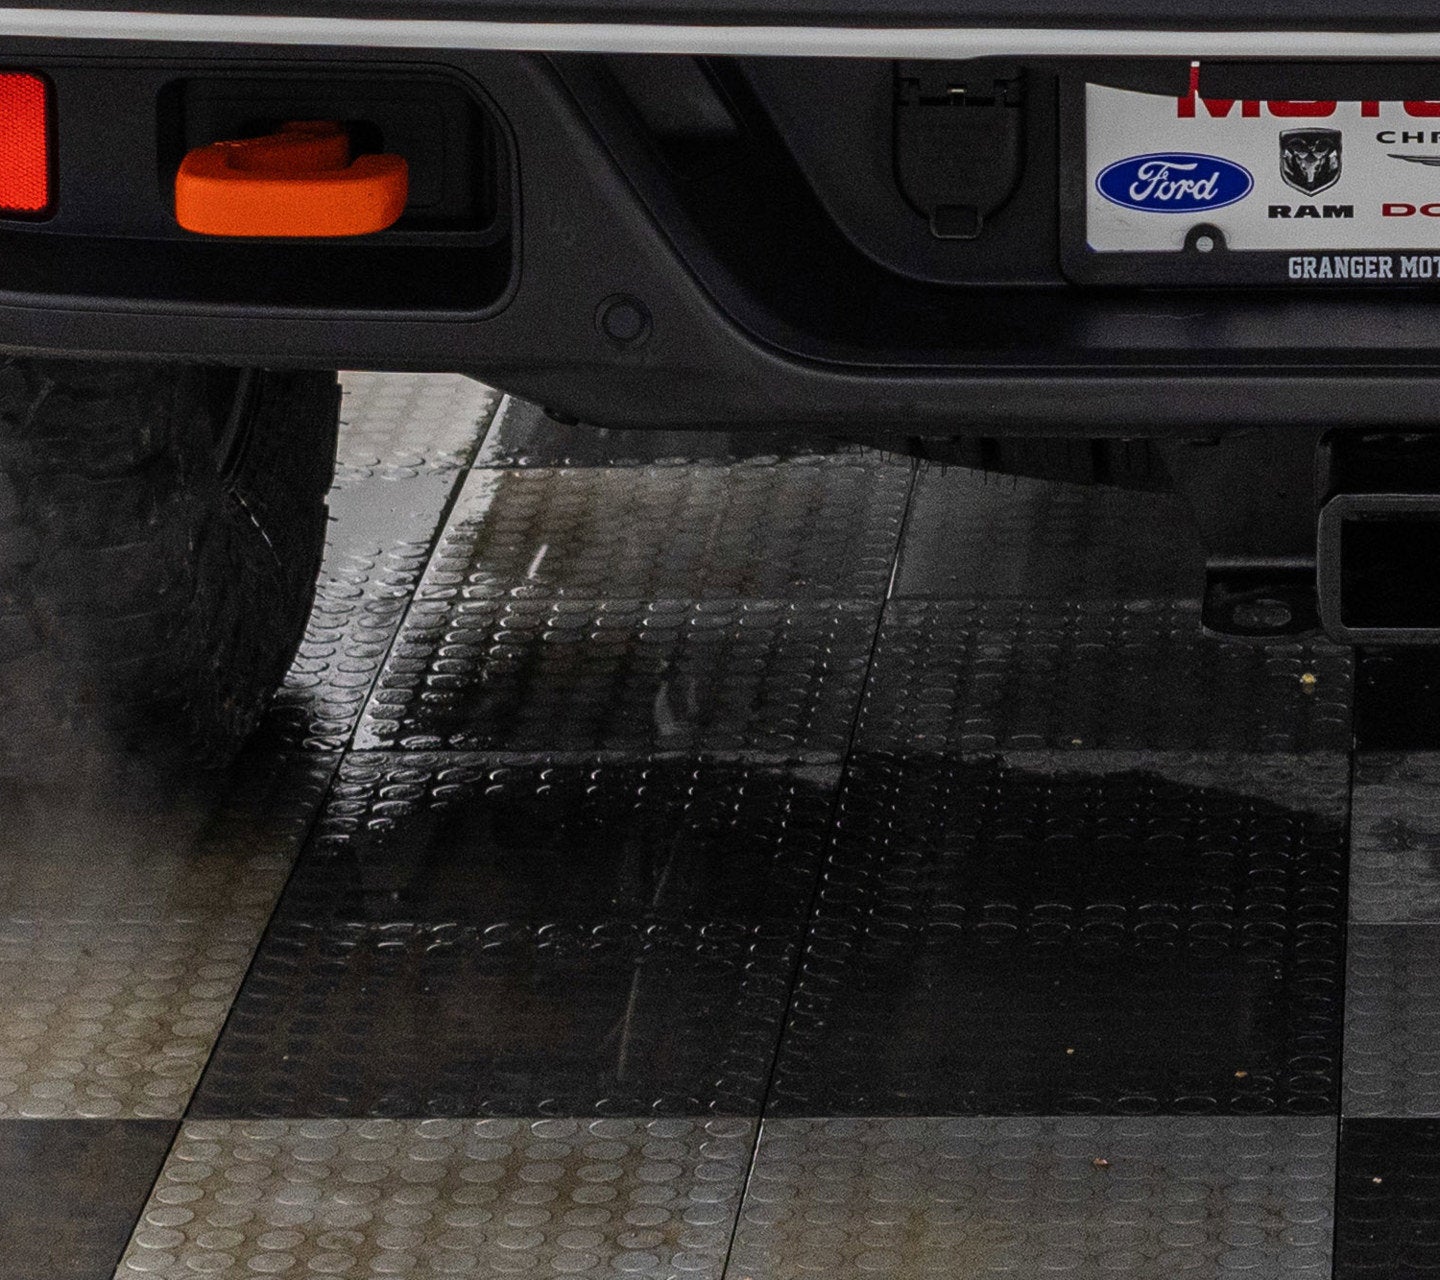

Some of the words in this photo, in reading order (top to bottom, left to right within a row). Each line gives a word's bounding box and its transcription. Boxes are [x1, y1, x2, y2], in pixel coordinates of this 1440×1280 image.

[1129, 161, 1220, 201] Ford
[1267, 204, 1355, 219] RAM
[1288, 256, 1393, 279] GRANGER
